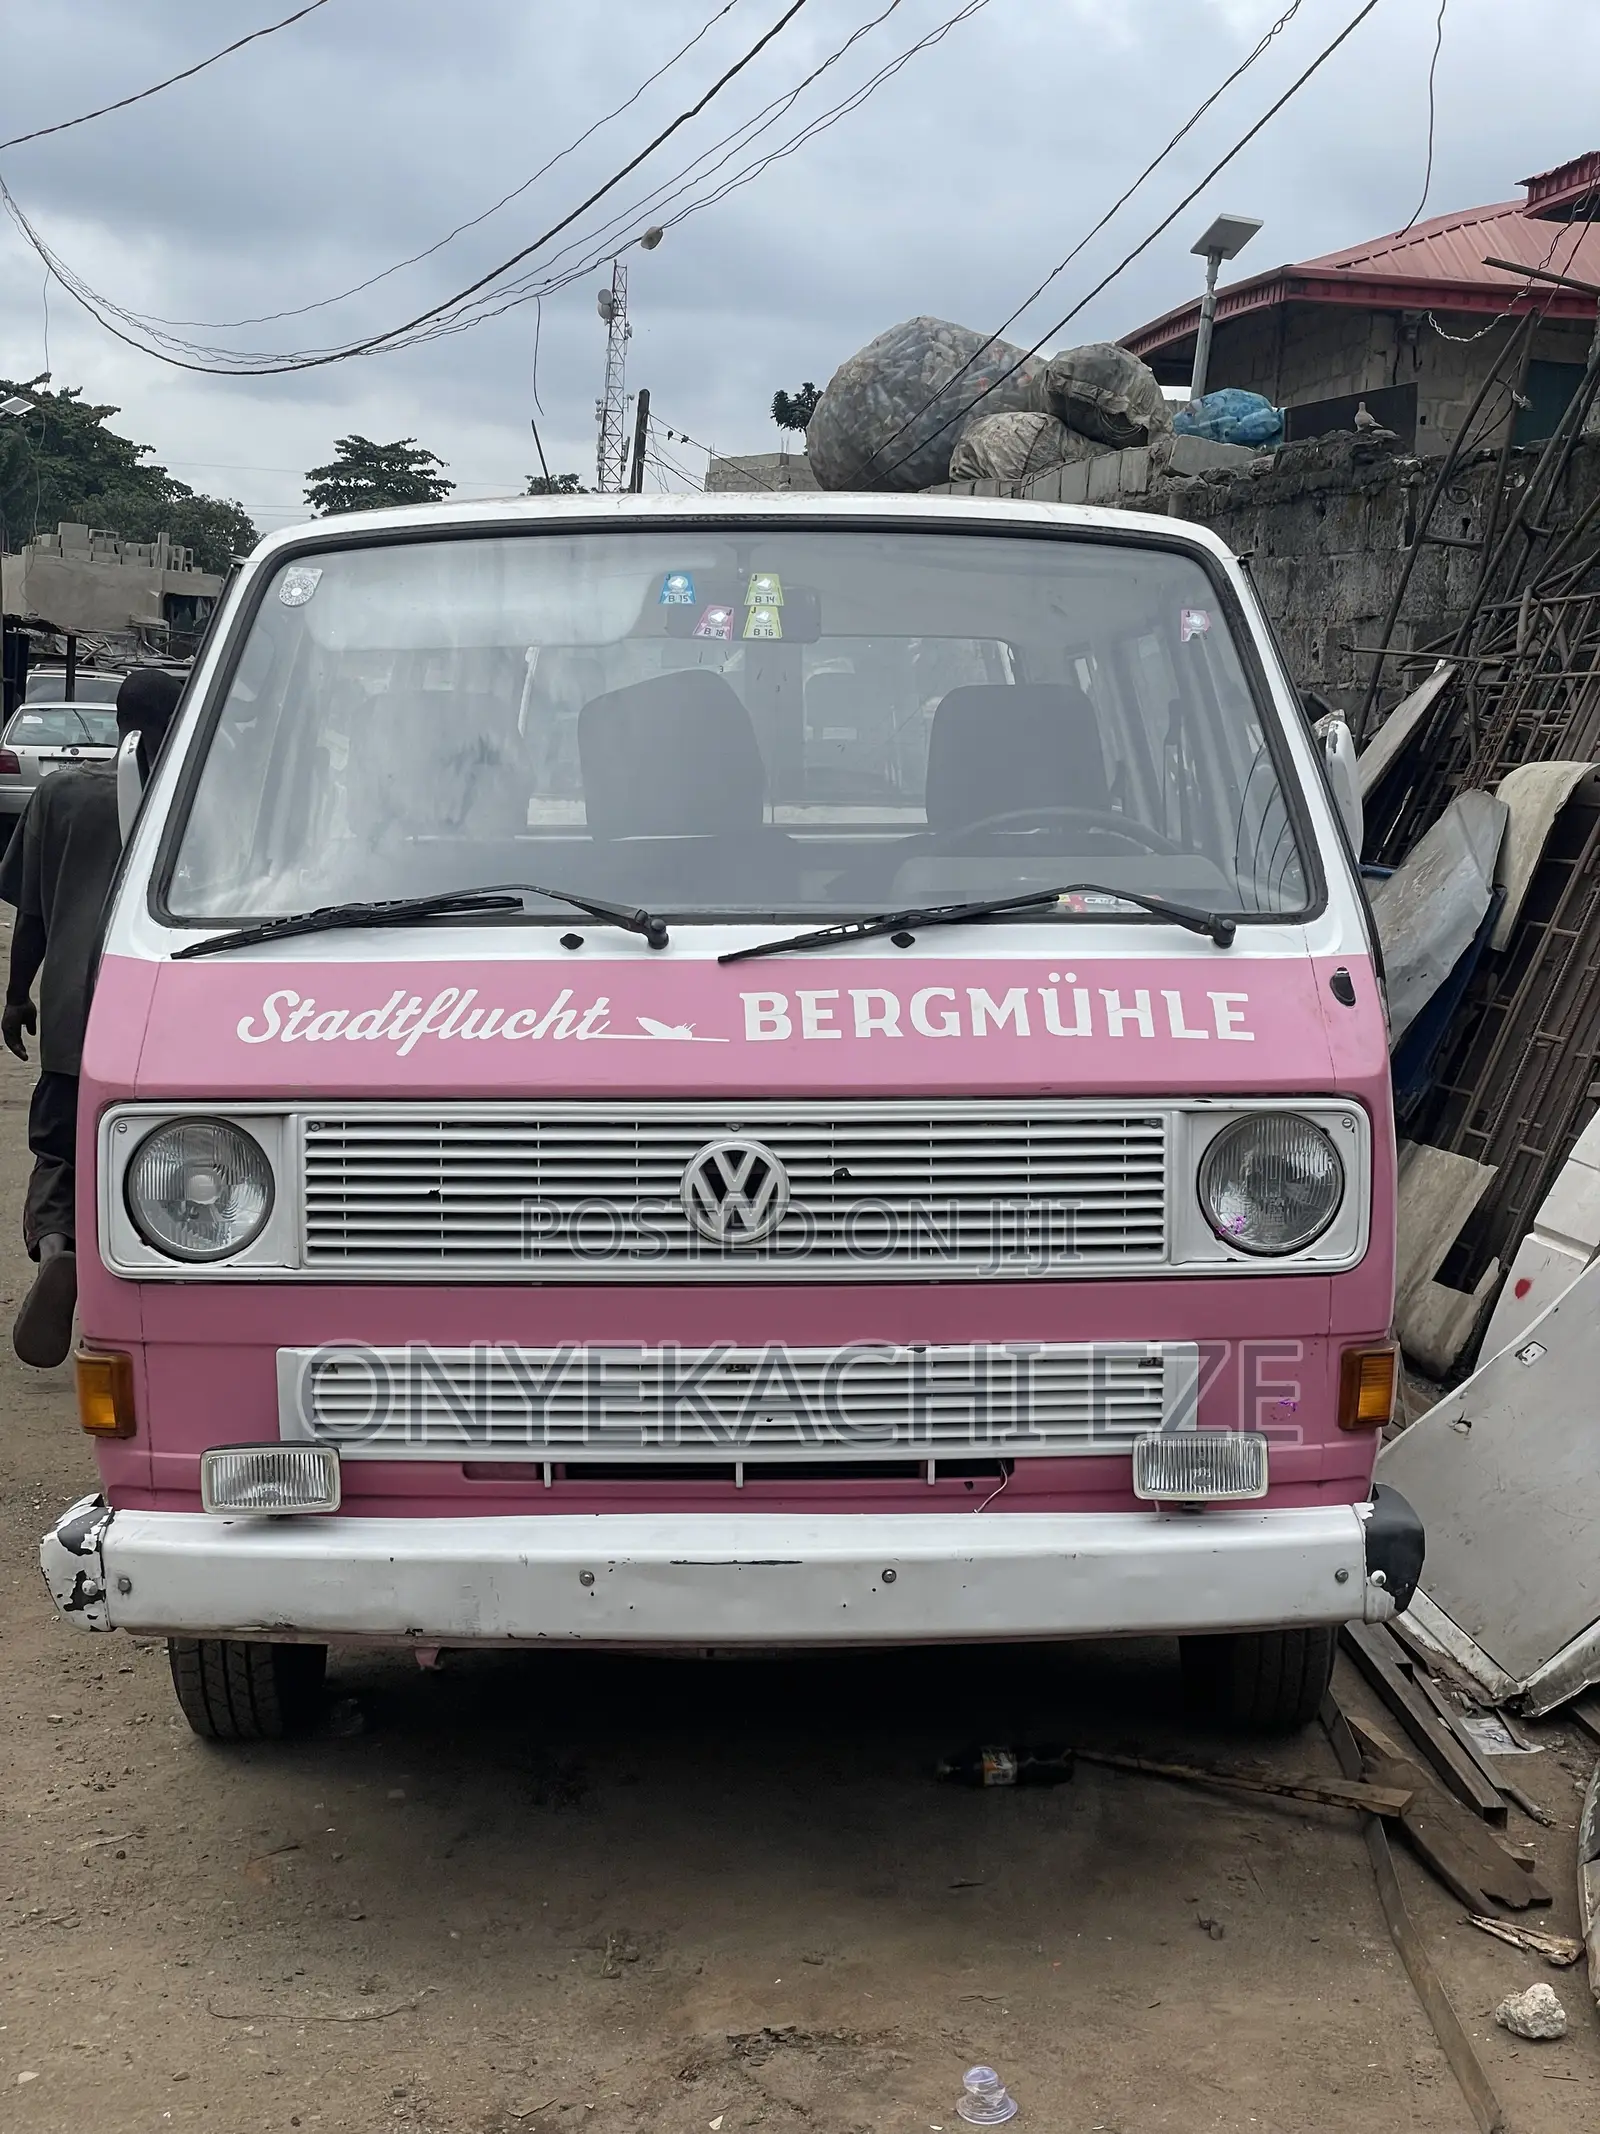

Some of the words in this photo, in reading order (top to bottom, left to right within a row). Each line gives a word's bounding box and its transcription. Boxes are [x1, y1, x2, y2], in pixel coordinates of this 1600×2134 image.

[751, 574, 758, 582] J
[668, 595, 676, 603] B
[679, 595, 689, 603] 15
[754, 595, 762, 603] B
[766, 596, 775, 604] 14
[751, 606, 757, 614] J
[704, 627, 711, 635] B
[753, 628, 760, 636] B
[765, 628, 774, 636] 16
[237, 987, 610, 1056] Stadtflucht
[739, 972, 1255, 1041] BERGMÜHLE
[684, 1140, 789, 1243] VW
